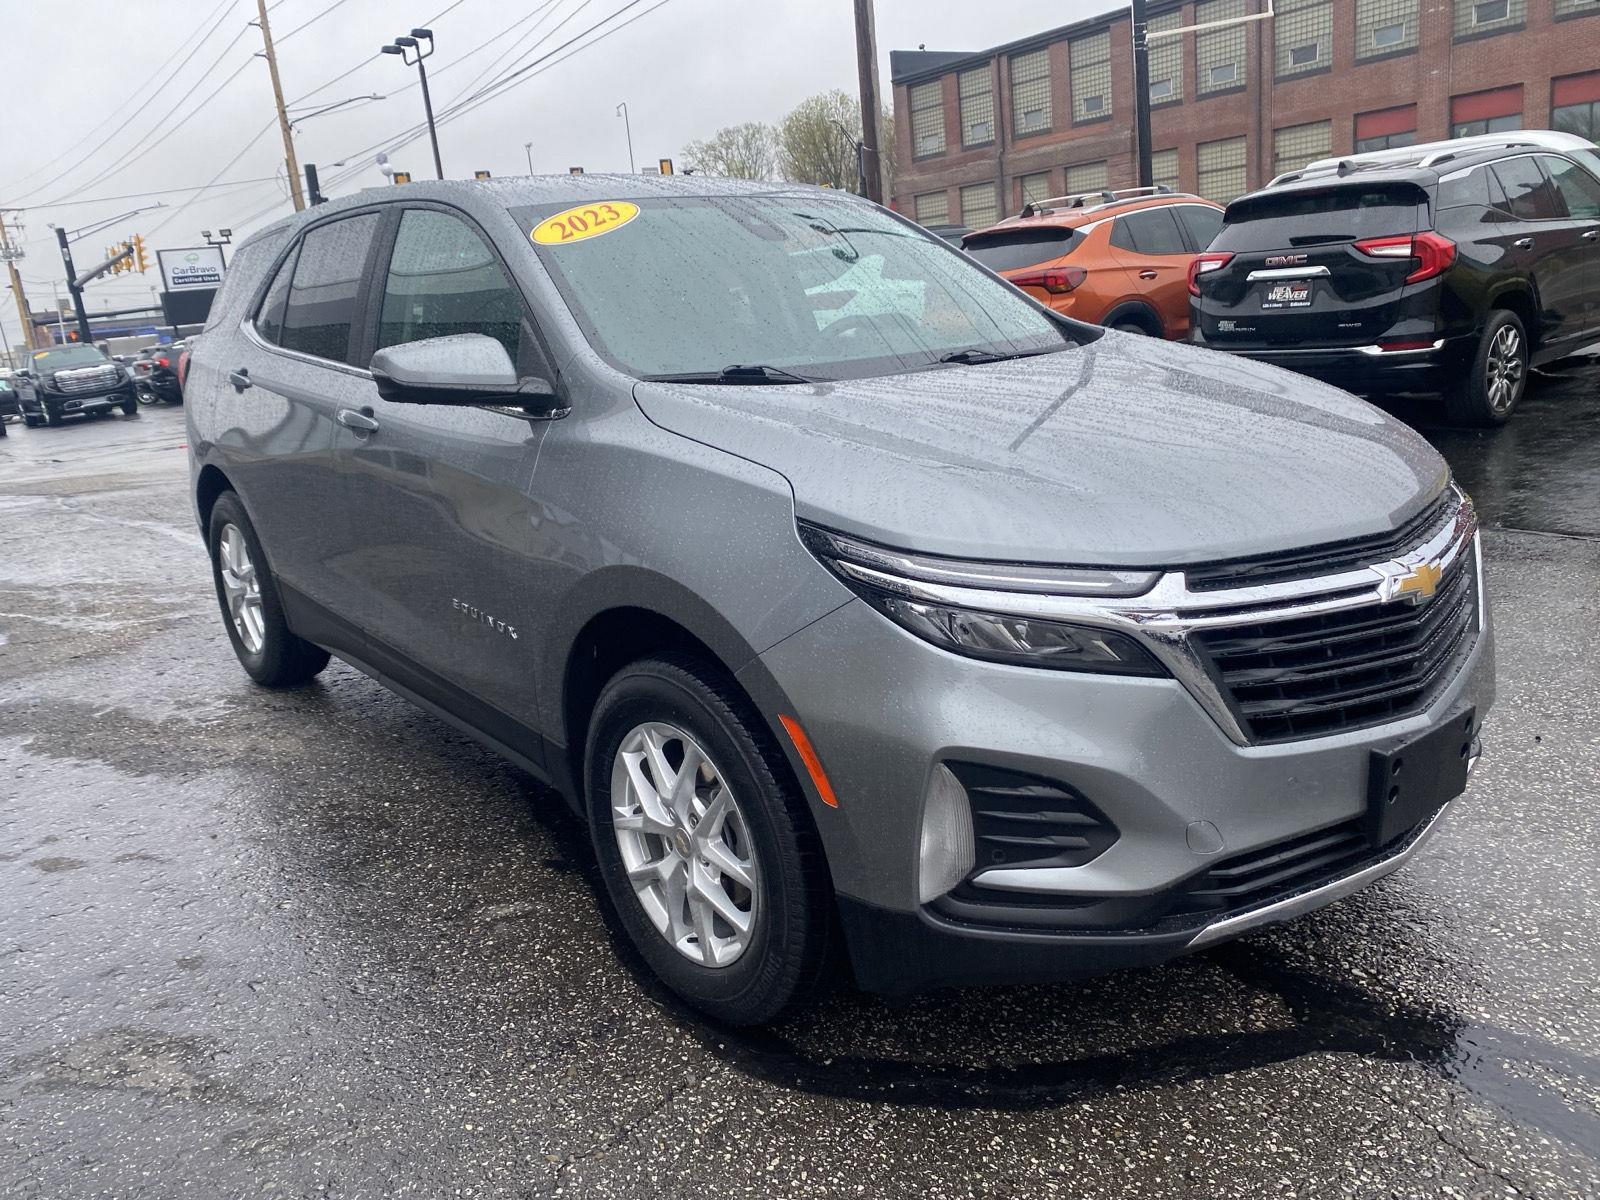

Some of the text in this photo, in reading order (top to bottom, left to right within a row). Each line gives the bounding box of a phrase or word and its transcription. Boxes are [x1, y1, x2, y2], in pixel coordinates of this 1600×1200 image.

[550, 204, 620, 240] 2023
[1265, 254, 1308, 266] GMC
[172, 265, 216, 275] CarBravo
[174, 276, 203, 284] Certified
[1268, 290, 1308, 301] WEAVER
[452, 598, 518, 639] EQUINOX
